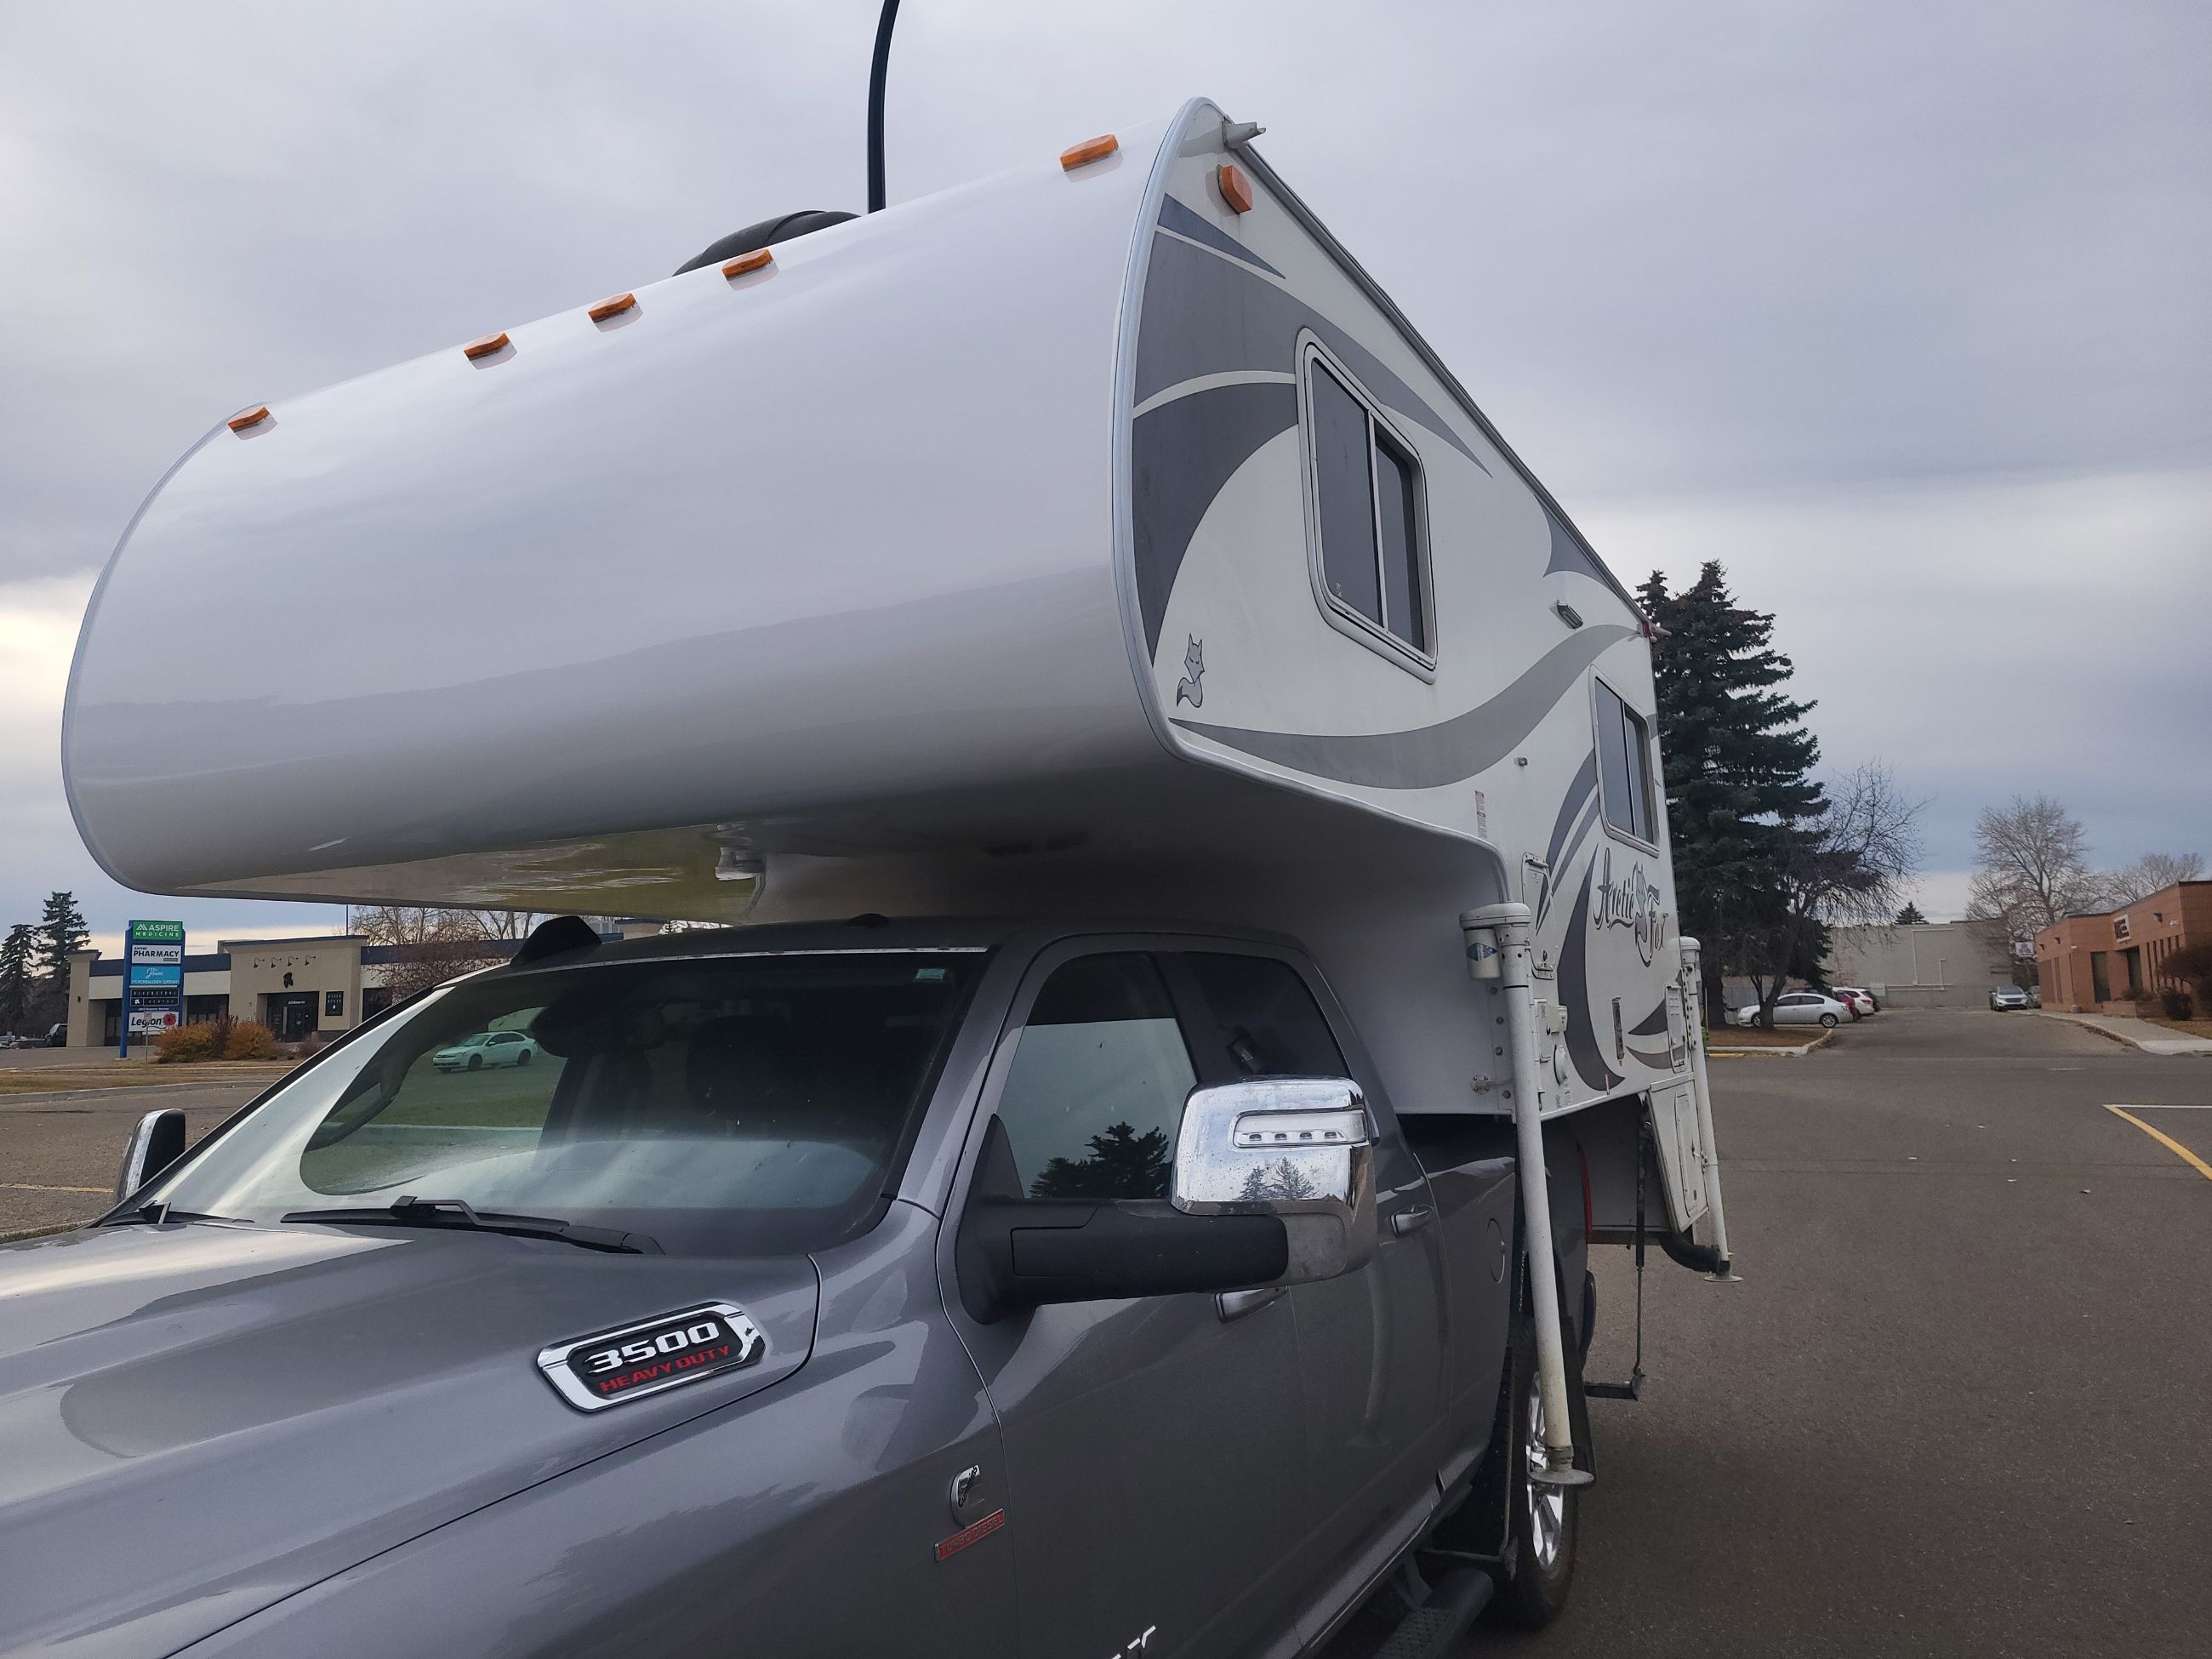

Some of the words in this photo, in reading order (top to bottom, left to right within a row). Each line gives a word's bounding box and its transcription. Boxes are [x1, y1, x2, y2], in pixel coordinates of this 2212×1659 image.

[1593, 847, 1635, 930] Arctic
[131, 1017, 162, 1028] Legion
[585, 1323, 720, 1373] 3500
[599, 1362, 671, 1393] HEAVY
[675, 1344, 730, 1370] DUTY
